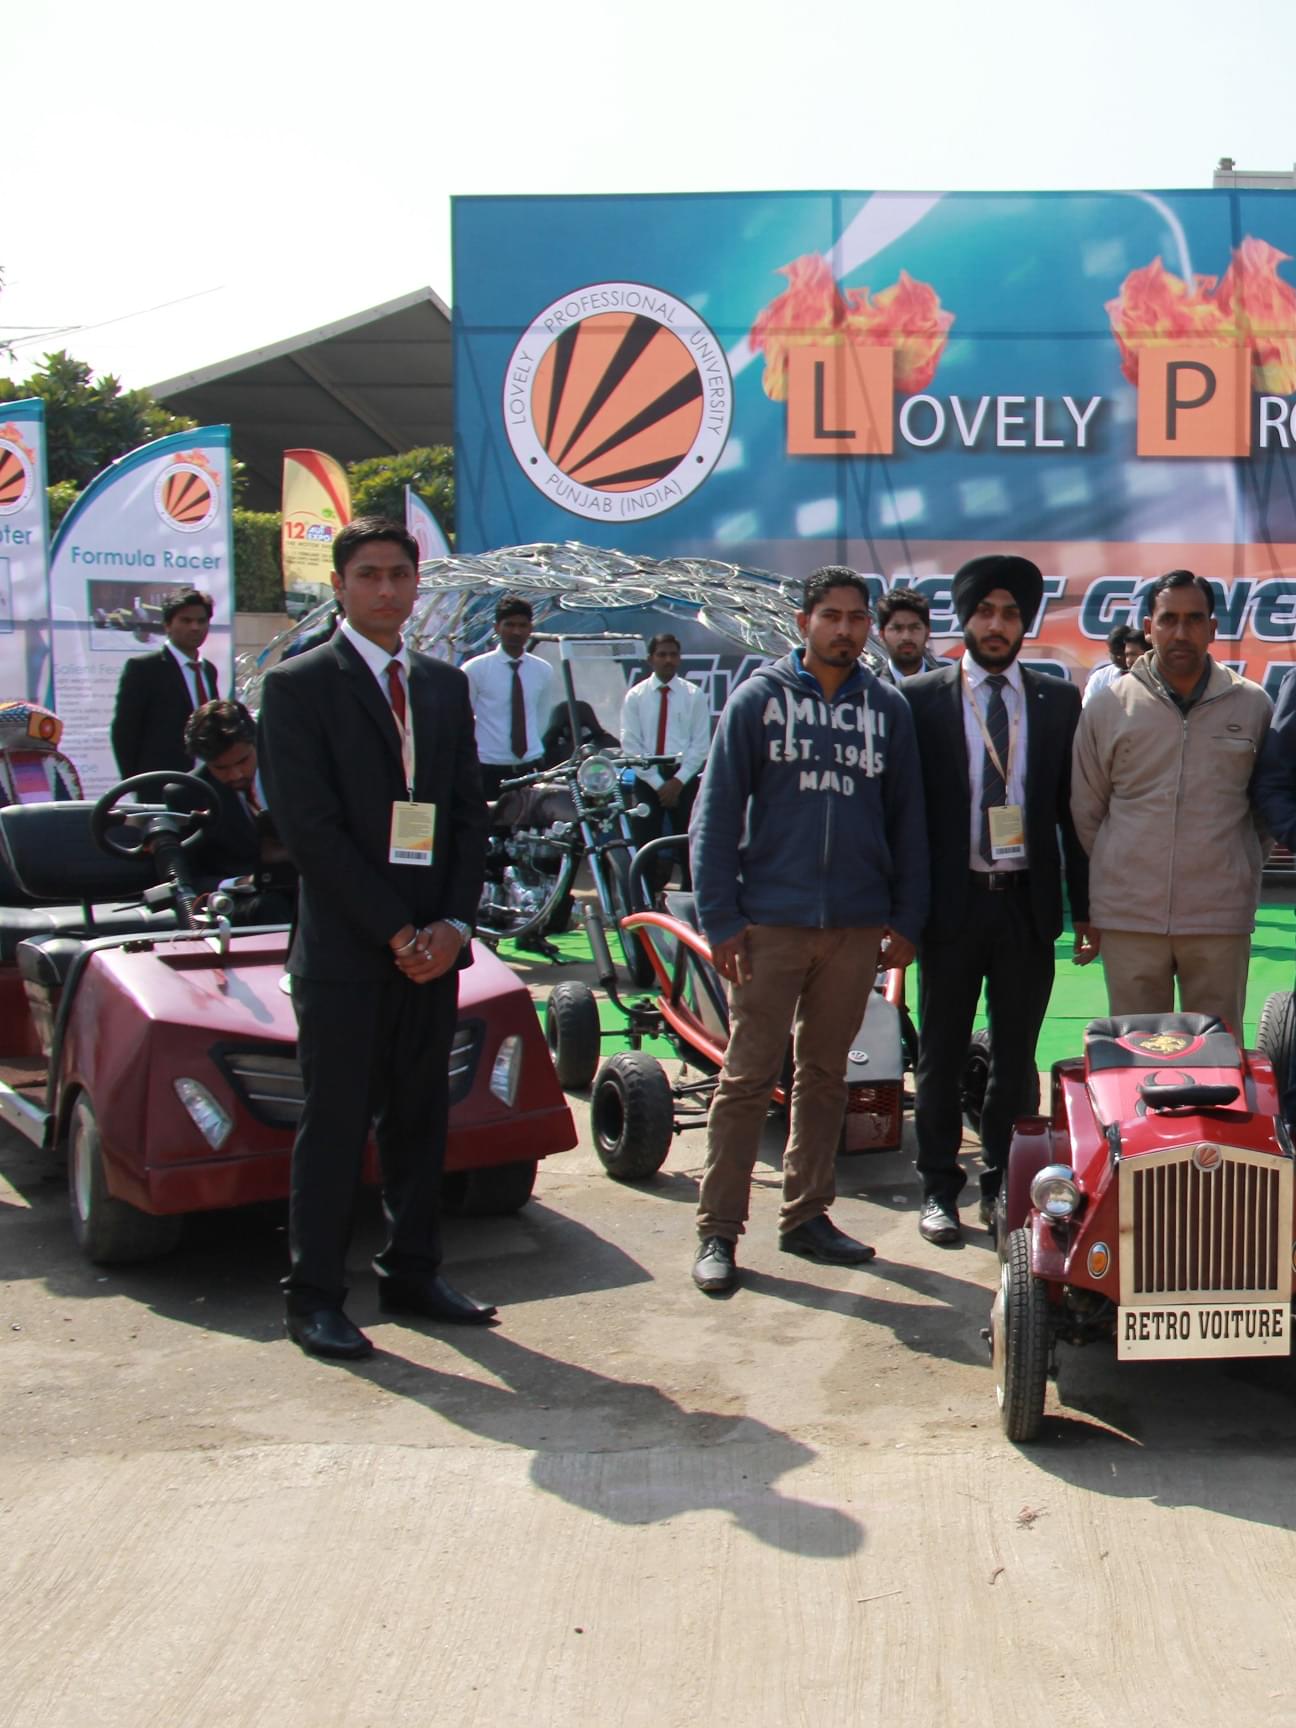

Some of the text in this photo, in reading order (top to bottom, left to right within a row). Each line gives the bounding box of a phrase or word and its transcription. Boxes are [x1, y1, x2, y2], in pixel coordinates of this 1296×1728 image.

[510, 290, 725, 436] LOVELY PROFESSIONAL UNIVERSITY
[545, 473, 683, 516] PUNJAB (INDIA)
[285, 521, 305, 539] 12
[71, 546, 221, 569] Formula Racer
[769, 739, 821, 762] EST.
[799, 770, 855, 796] MAD
[1124, 1308, 1284, 1341] RETRO VOITURE
